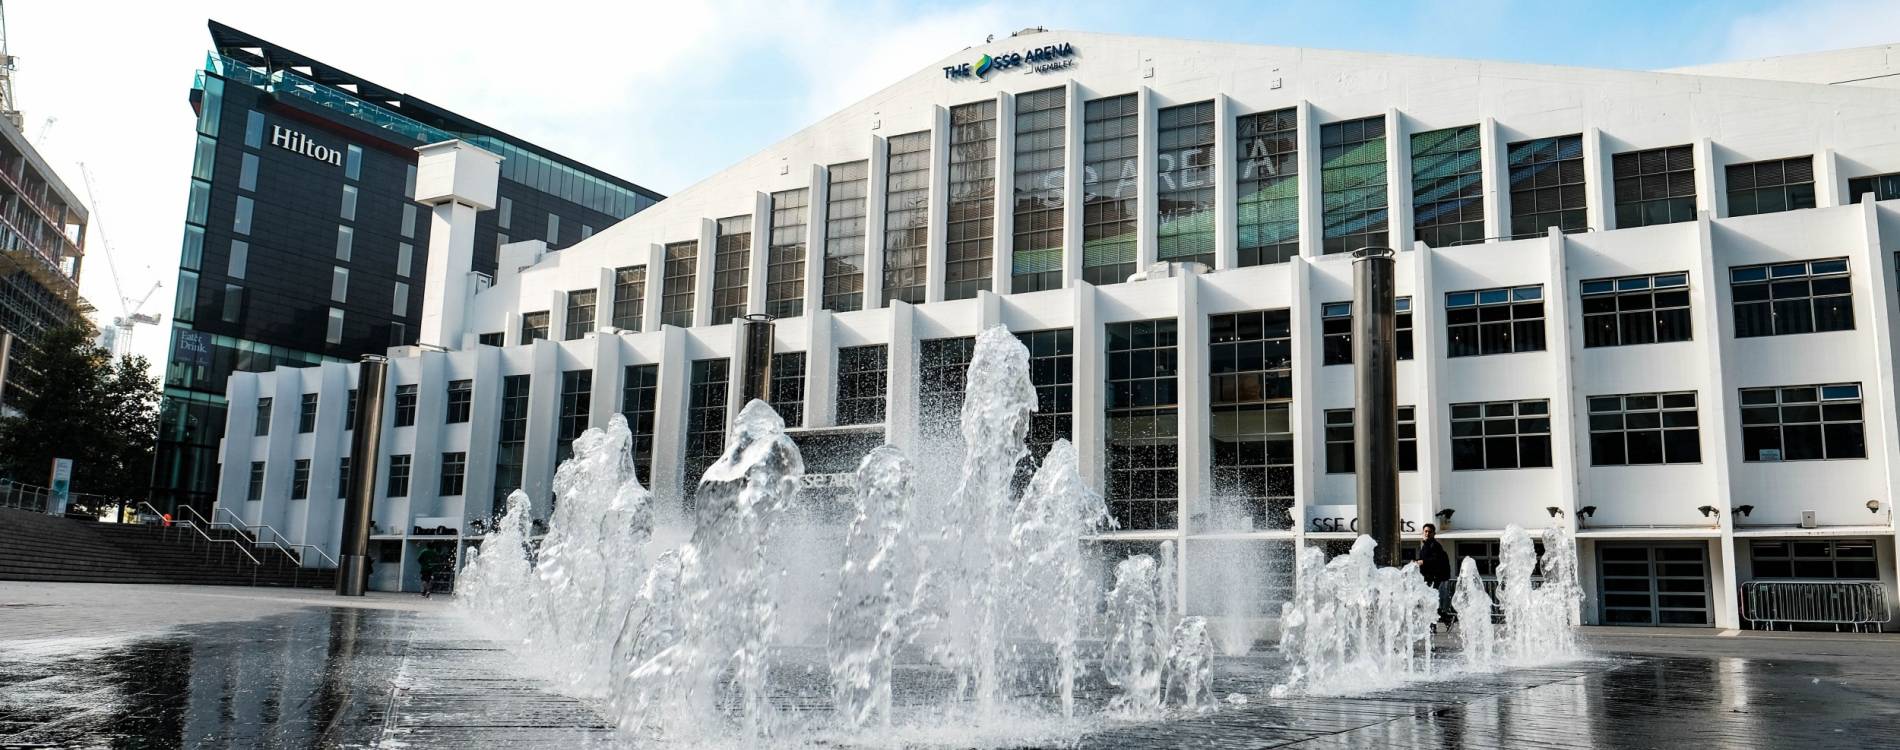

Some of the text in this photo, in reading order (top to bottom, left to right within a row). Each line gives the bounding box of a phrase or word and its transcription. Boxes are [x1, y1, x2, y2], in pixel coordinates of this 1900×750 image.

[943, 62, 971, 79] THE
[1024, 42, 1073, 63] ARENA
[1034, 59, 1073, 73] WEMBLEY
[271, 124, 342, 167] Hilton
